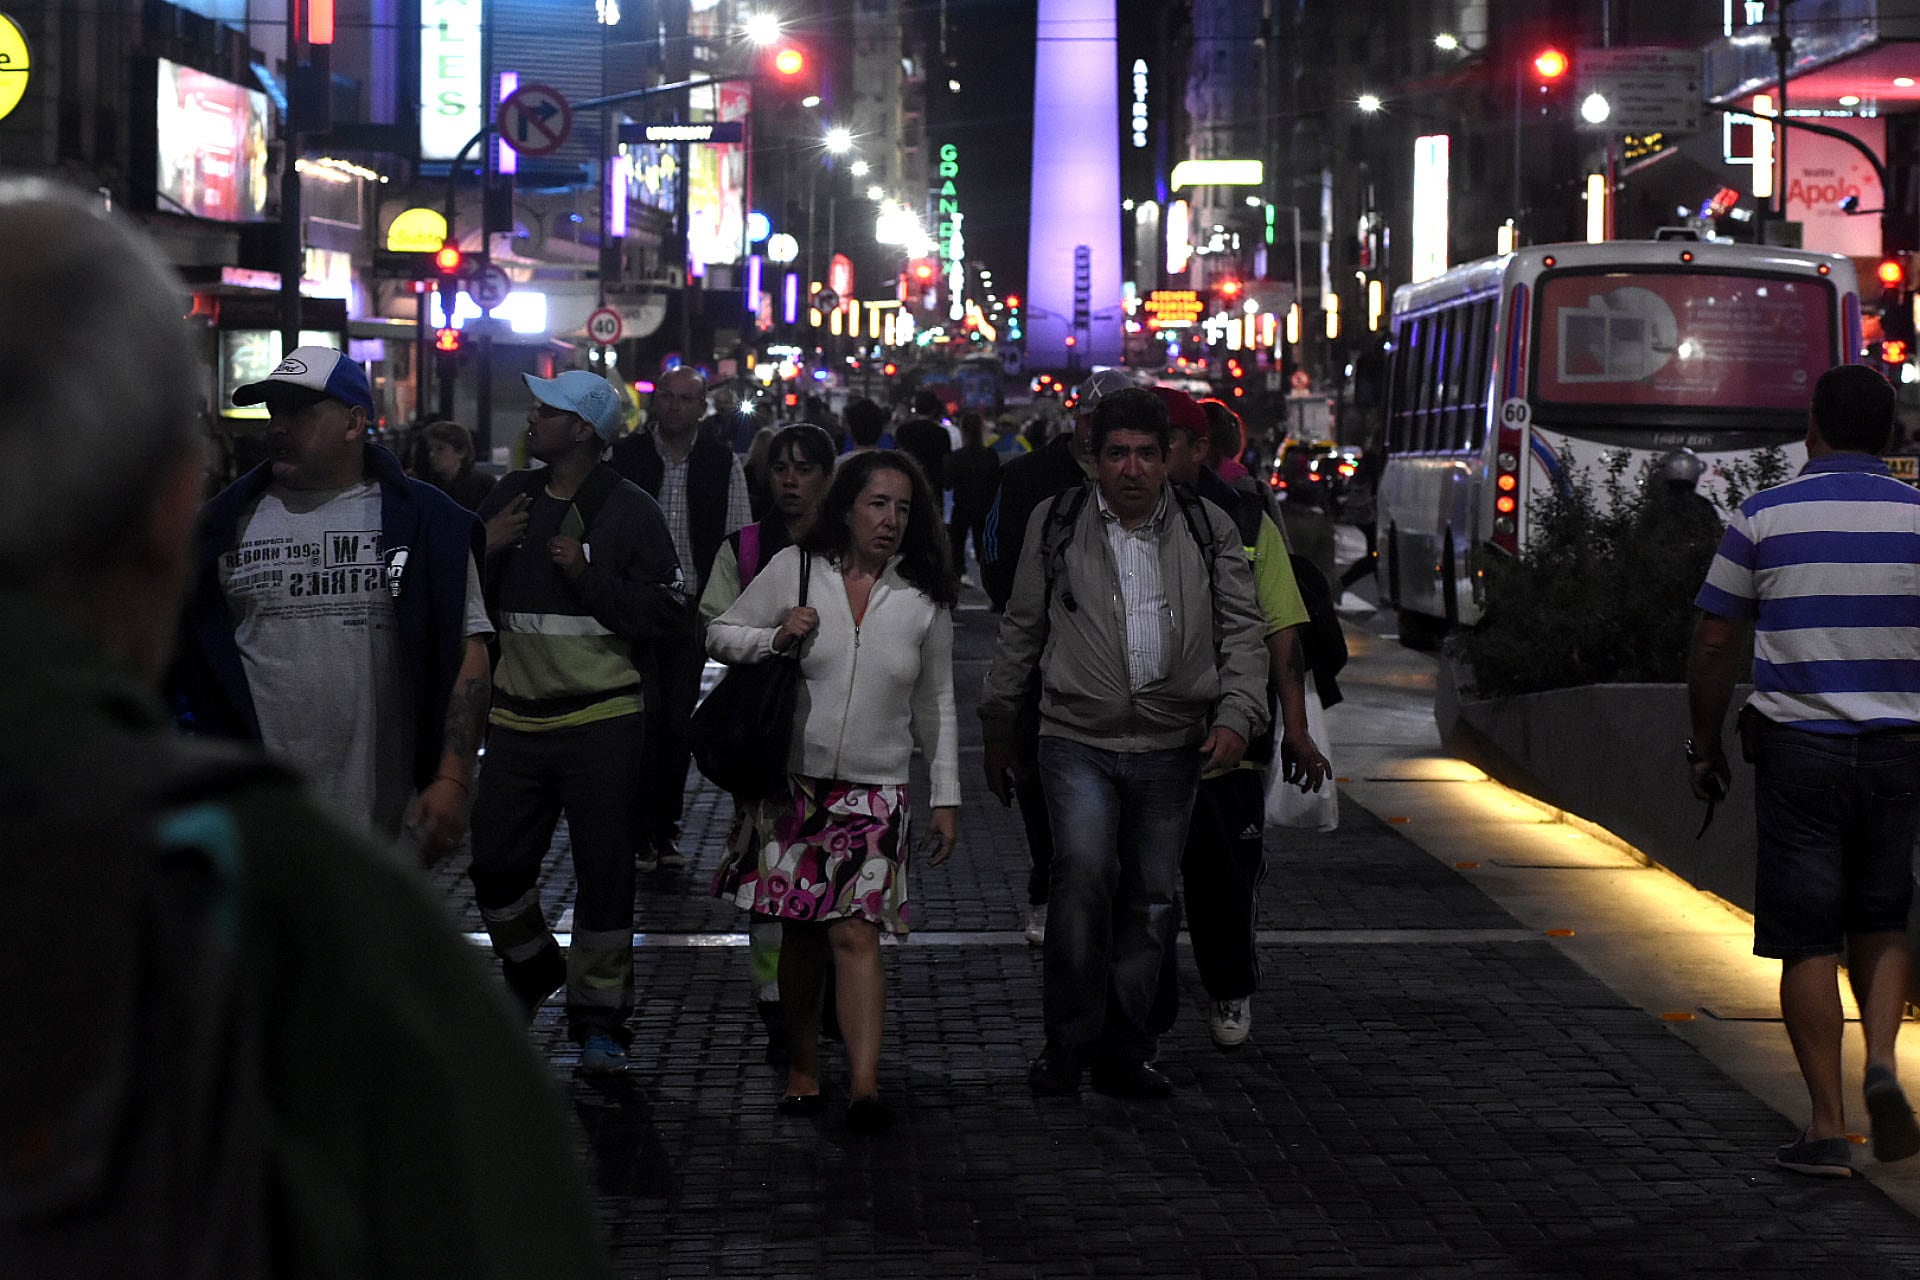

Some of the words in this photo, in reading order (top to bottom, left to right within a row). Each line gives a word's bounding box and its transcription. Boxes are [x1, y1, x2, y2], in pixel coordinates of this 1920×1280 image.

[435, 0, 467, 116] LES
[1787, 176, 1860, 209] Apolo
[594, 319, 615, 334] 40
[1505, 404, 1526, 421] 60
[226, 548, 280, 569] REBORN
